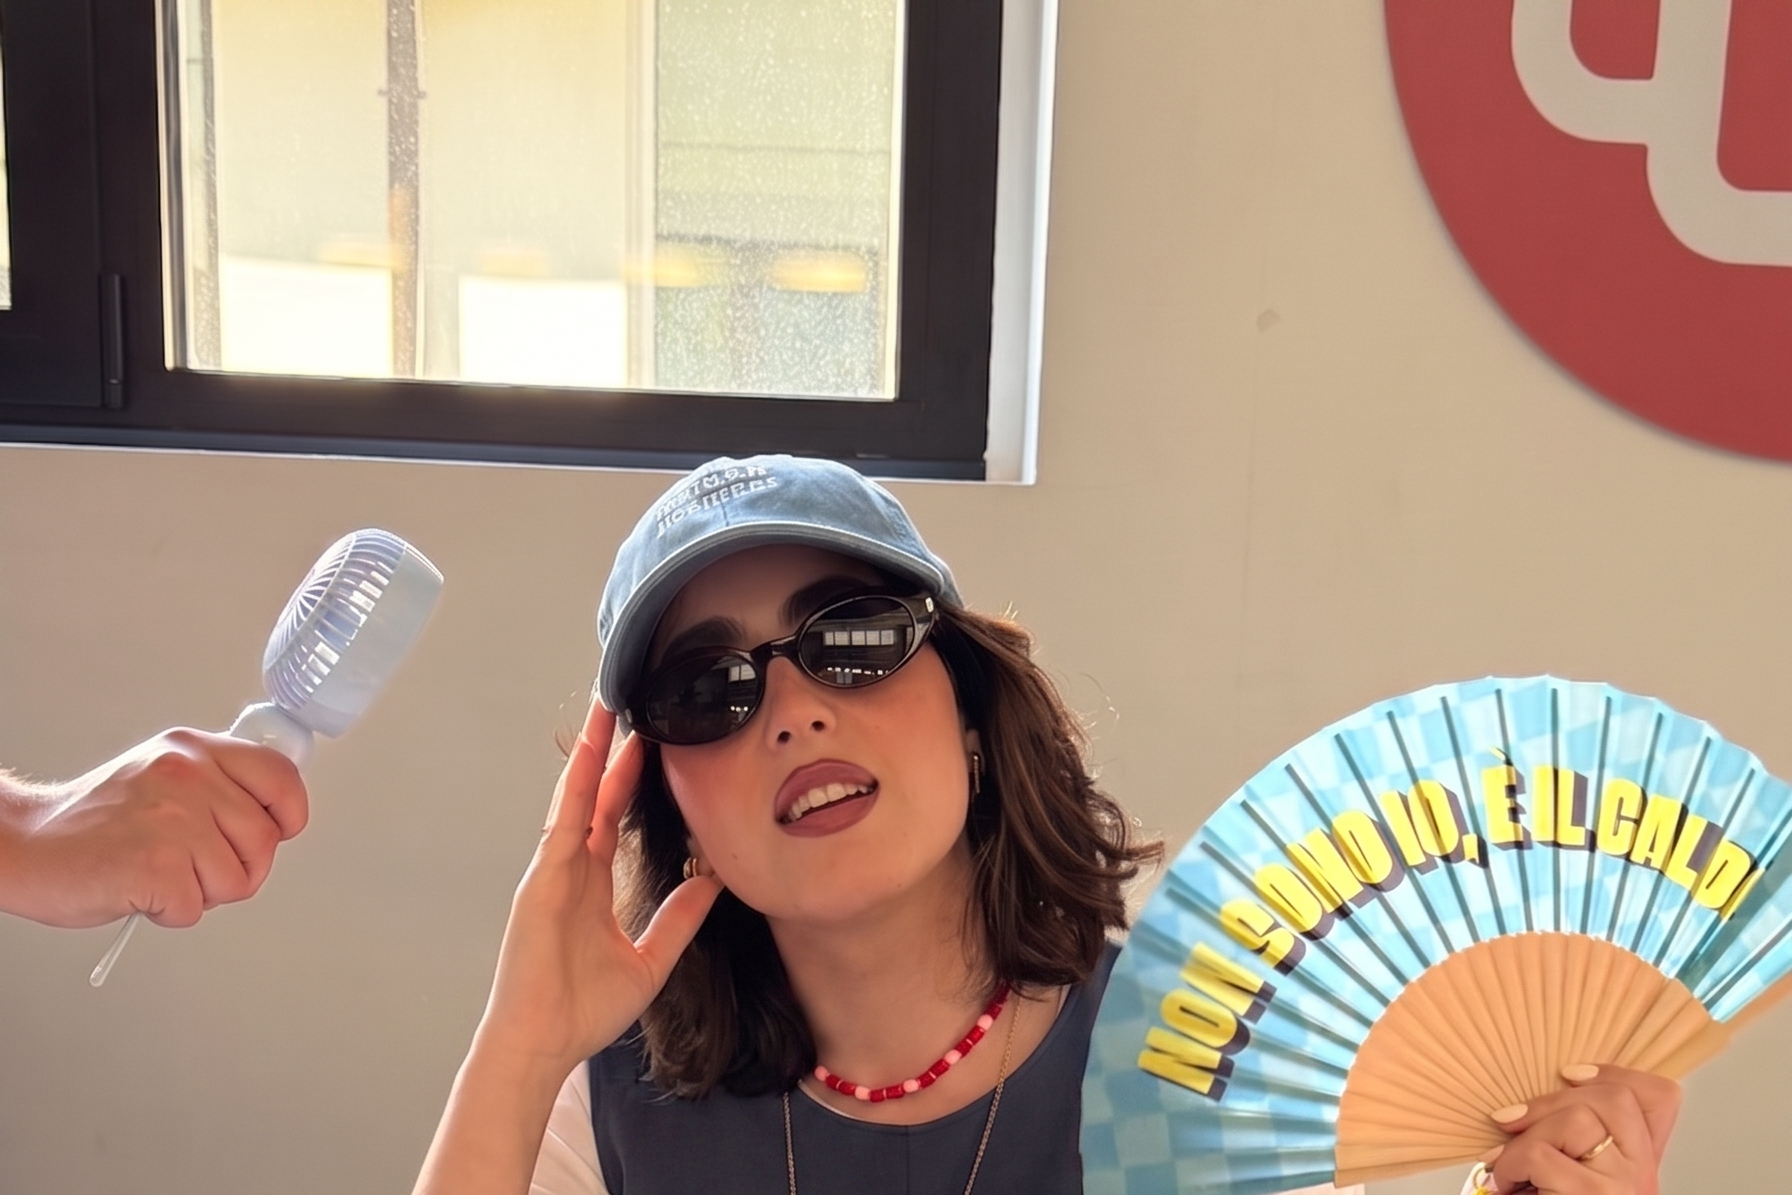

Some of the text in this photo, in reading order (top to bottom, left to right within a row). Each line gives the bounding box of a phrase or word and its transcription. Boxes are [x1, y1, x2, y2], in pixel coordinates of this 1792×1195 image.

[1137, 942, 1270, 1098] NON
[1220, 808, 1396, 974] SONO
[1380, 779, 1482, 866] IO,
[1481, 747, 1526, 848] È
[1532, 765, 1592, 850] IL
